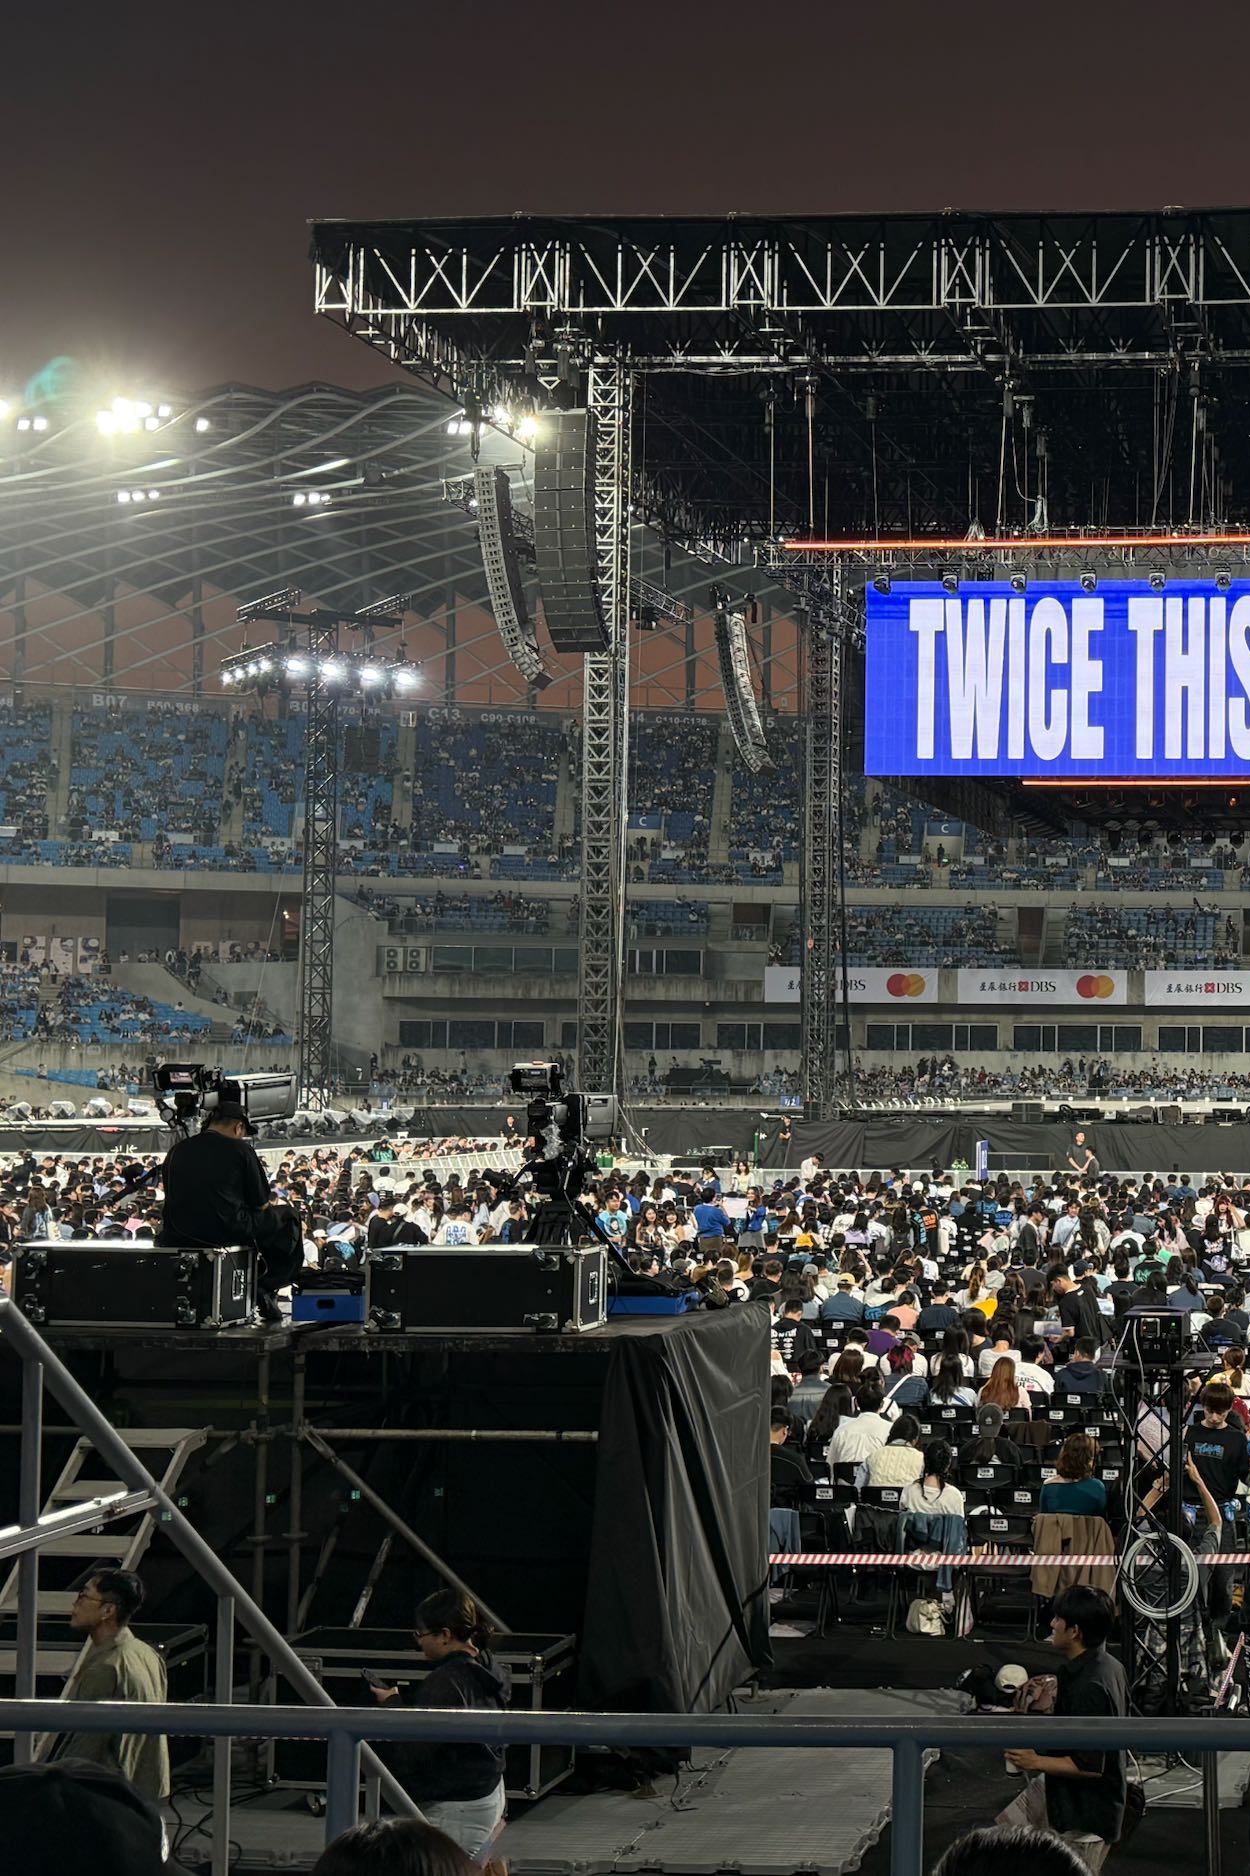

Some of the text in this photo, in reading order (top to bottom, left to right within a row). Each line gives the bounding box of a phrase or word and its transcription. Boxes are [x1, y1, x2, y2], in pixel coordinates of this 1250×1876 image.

[909, 597, 1104, 761] TWICE
[92, 694, 127, 707] B07
[428, 708, 461, 721] C13
[638, 816, 648, 827] C
[940, 823, 950, 834] C
[1030, 981, 1057, 992] DBS
[1217, 983, 1243, 994] DBS
